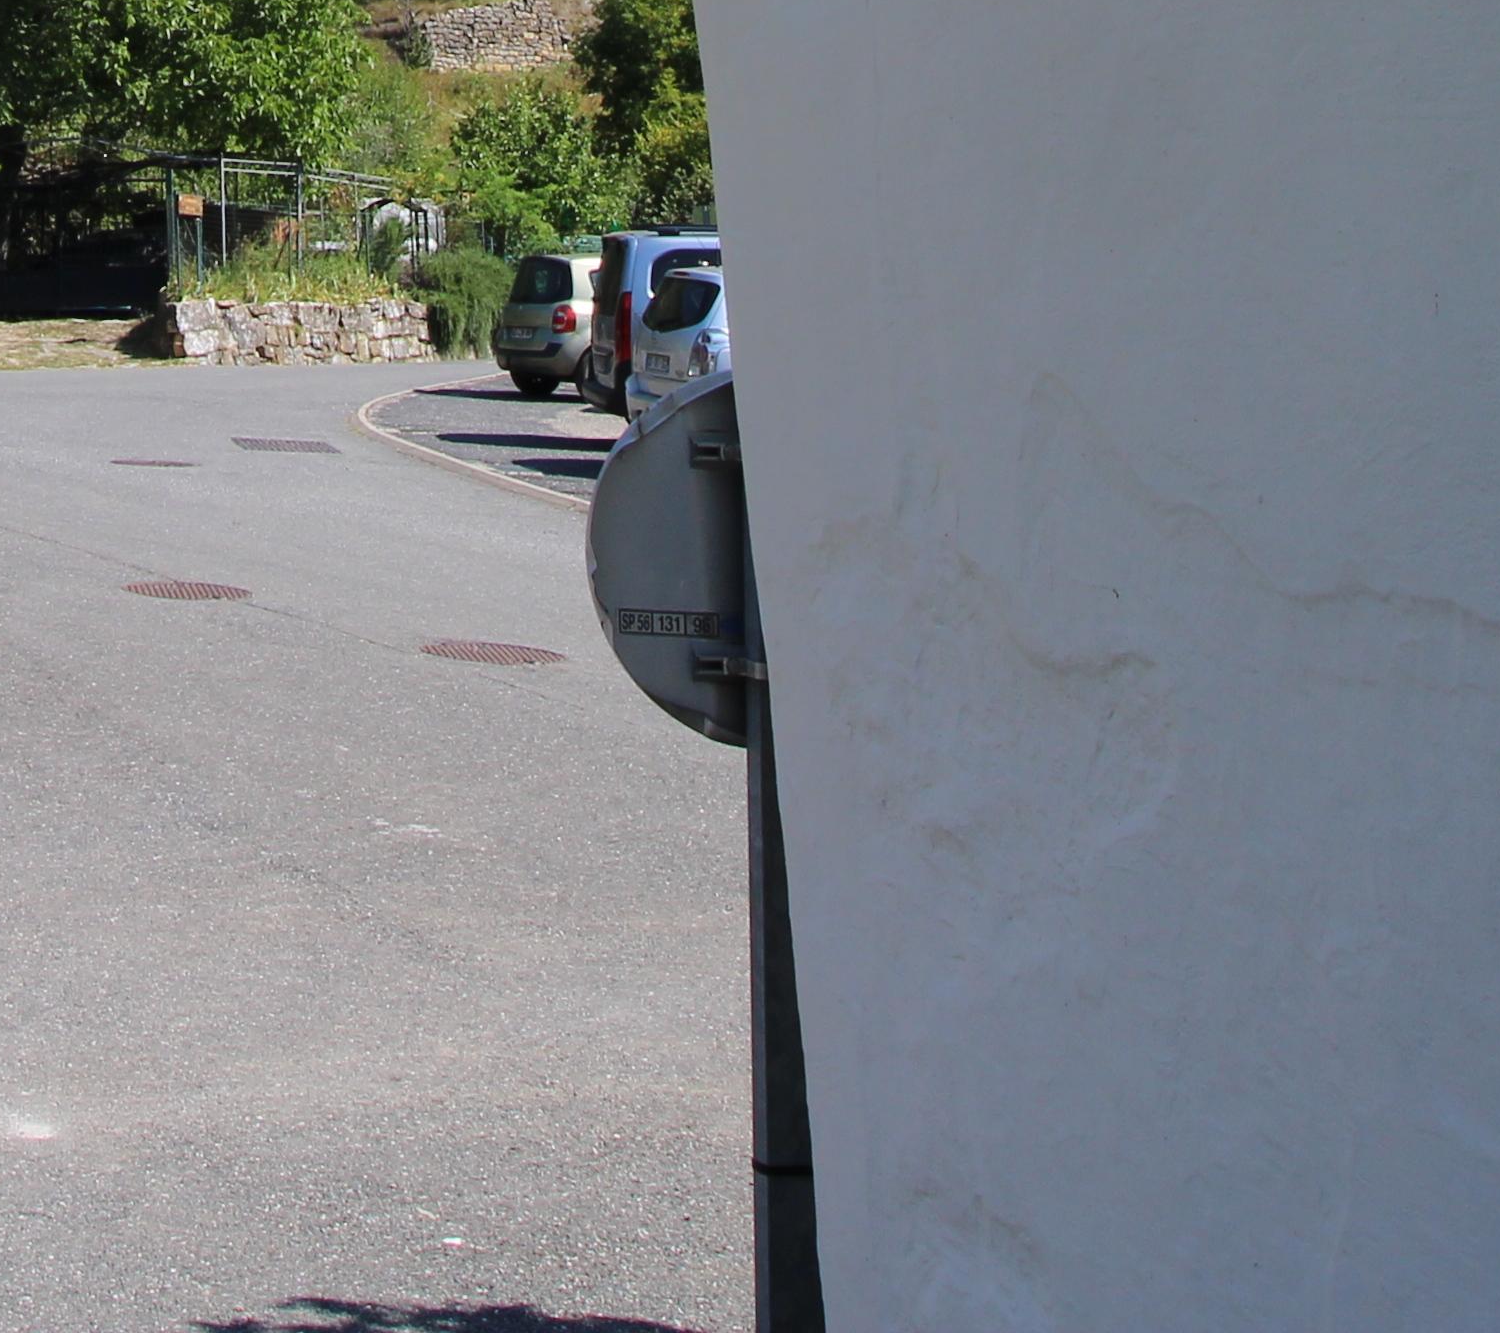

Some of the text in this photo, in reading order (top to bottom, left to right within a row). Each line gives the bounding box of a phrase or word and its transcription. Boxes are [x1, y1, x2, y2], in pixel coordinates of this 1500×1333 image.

[622, 613, 636, 631] SP
[636, 614, 651, 632] 56
[658, 615, 681, 633] 131
